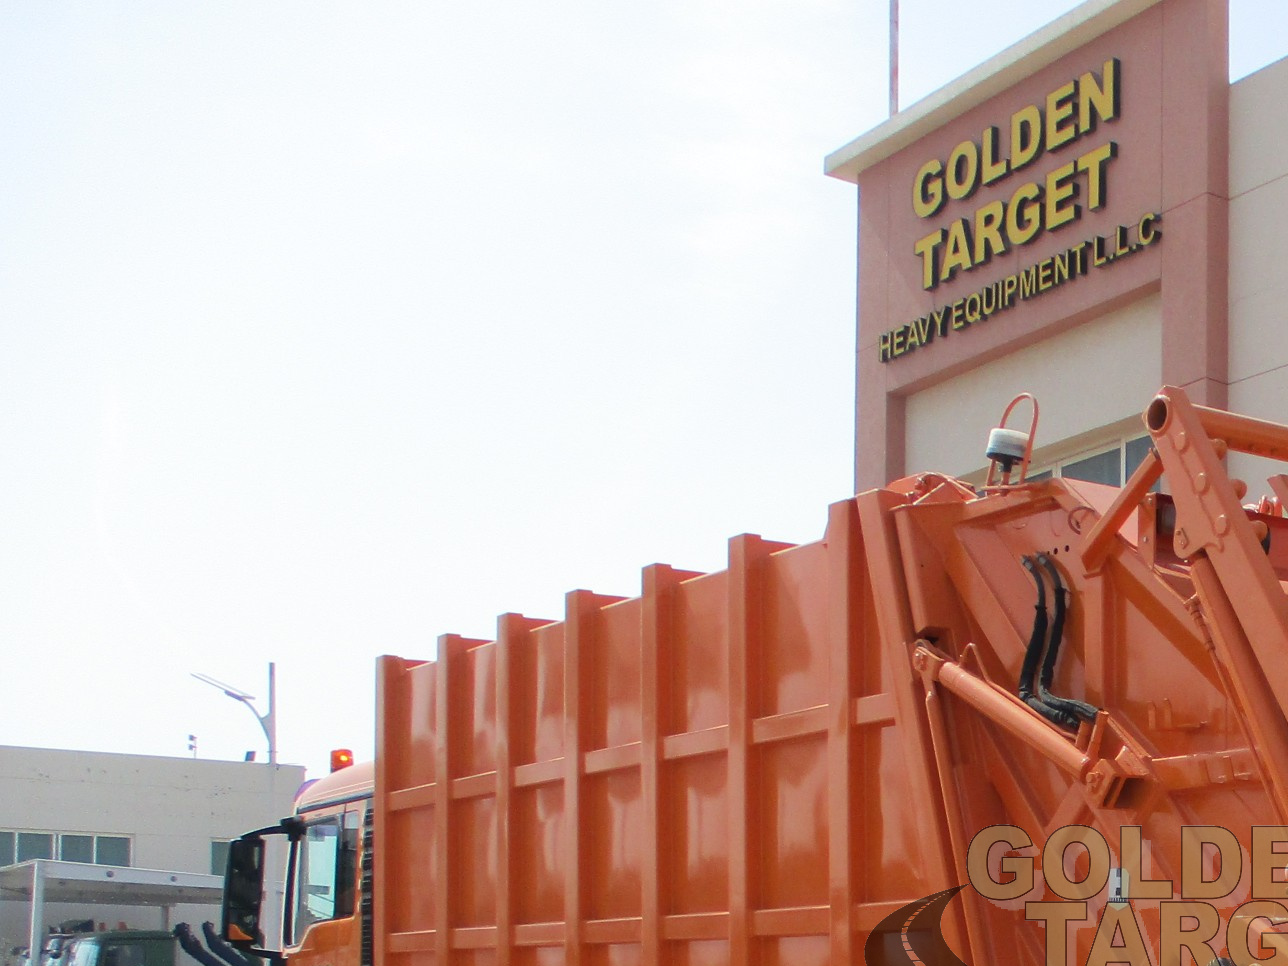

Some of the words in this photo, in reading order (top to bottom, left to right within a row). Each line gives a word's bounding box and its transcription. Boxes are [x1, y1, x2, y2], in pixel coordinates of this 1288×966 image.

[912, 57, 1119, 219] GOLDEN
[914, 141, 1117, 290] TARGET
[878, 304, 951, 362] HEAVY
[952, 241, 1088, 331] EQUIPMENT
